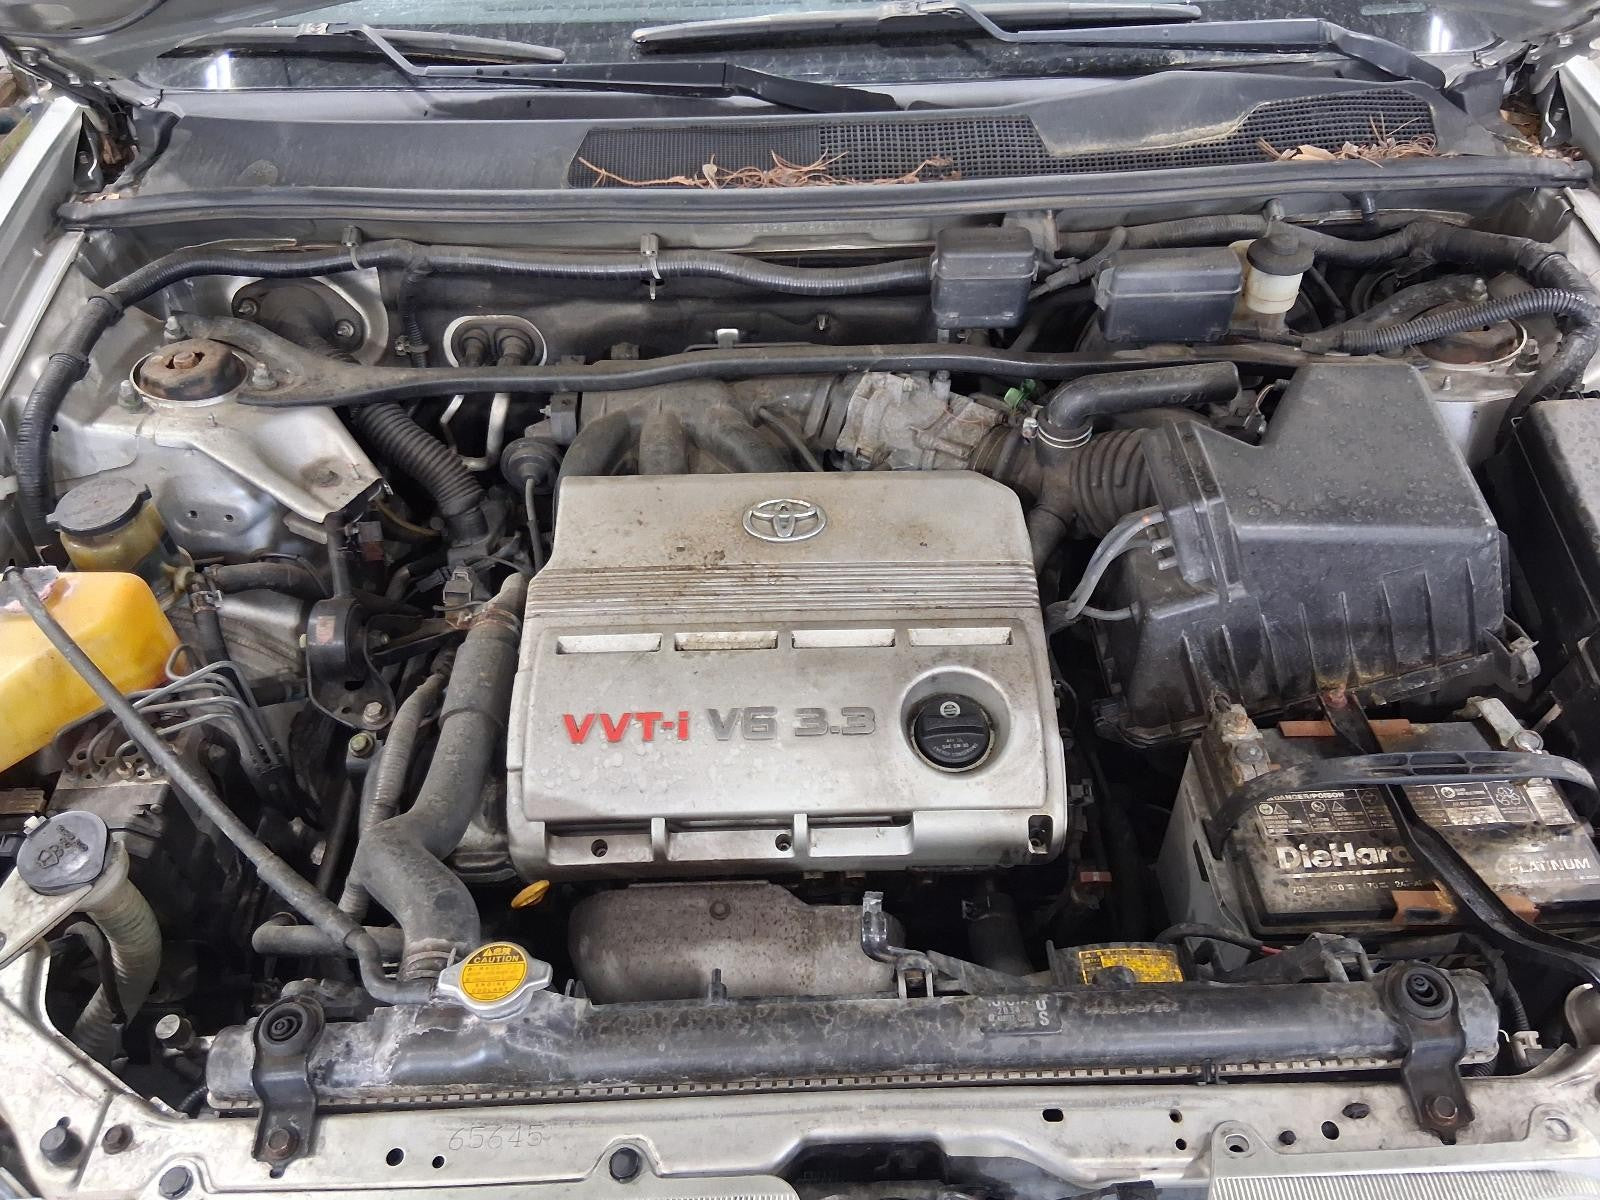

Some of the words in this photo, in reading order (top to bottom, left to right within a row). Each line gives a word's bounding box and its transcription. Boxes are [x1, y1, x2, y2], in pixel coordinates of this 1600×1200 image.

[563, 710, 690, 744] VVT-i
[706, 706, 778, 741] V6
[794, 706, 876, 737] 3.3
[1509, 857, 1591, 873] PLATINUM
[473, 955, 519, 964] CAUTION
[448, 1123, 545, 1151] 65645
